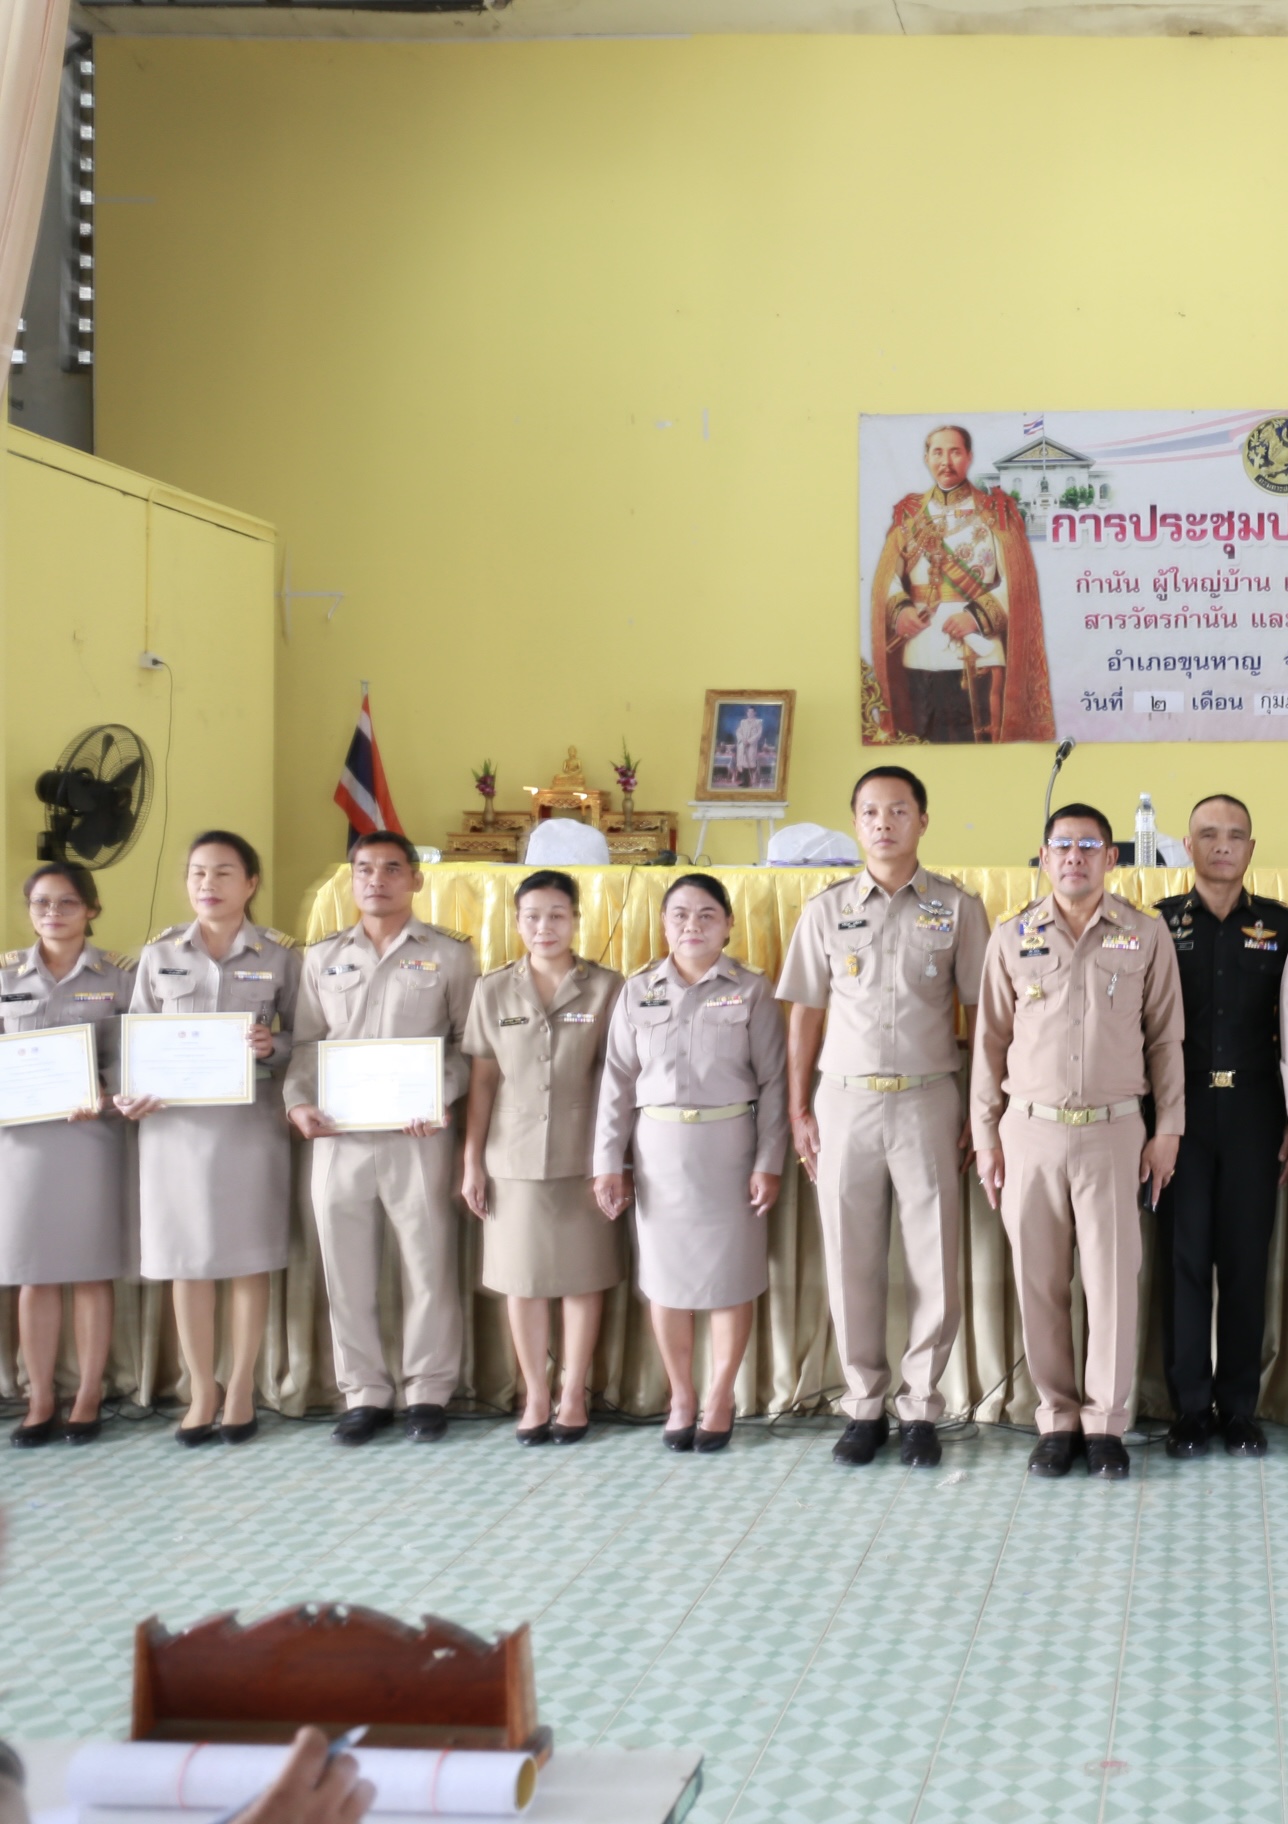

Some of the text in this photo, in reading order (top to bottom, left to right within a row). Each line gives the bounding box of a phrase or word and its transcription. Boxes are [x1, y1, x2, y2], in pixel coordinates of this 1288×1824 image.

[1075, 569, 1141, 594] กำนัน
[1152, 566, 1271, 602] ผู้ใหญ่บ้าน
[1084, 605, 1238, 630] สารวัตรกำนัน
[1107, 648, 1262, 680] อำเภอขุนหาญ
[1080, 686, 1124, 712] วันที่
[1150, 694, 1167, 713] ๒
[1191, 689, 1244, 711] เดือน
